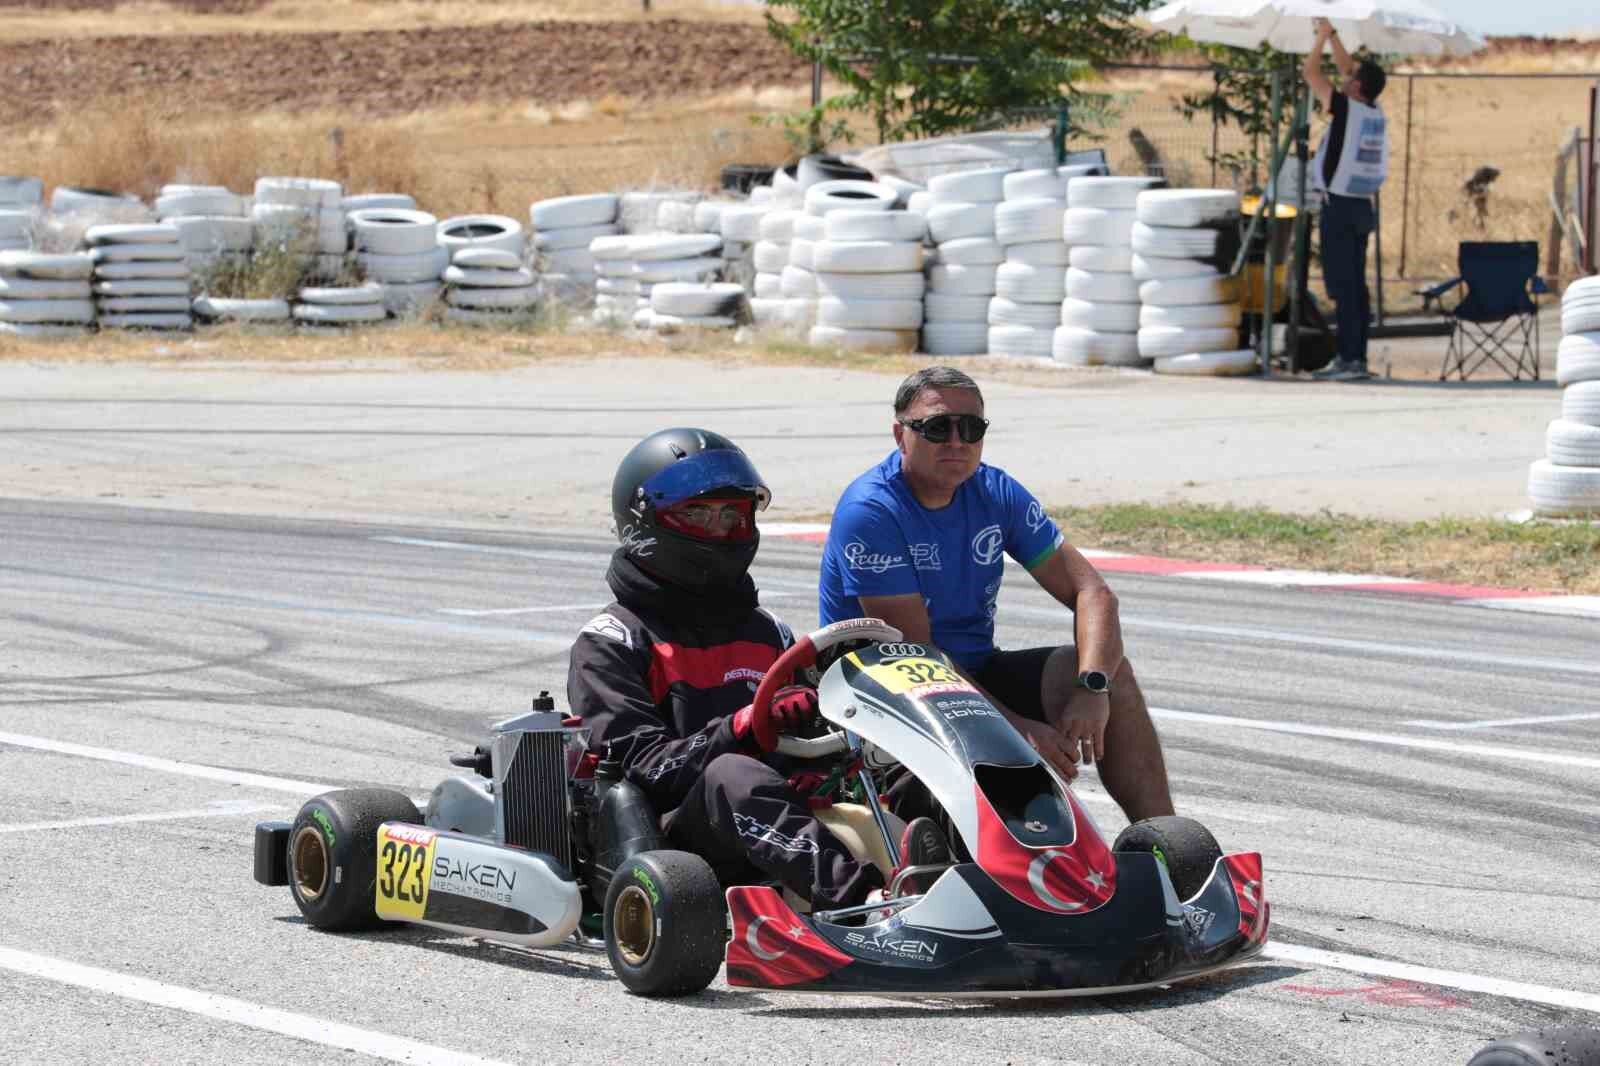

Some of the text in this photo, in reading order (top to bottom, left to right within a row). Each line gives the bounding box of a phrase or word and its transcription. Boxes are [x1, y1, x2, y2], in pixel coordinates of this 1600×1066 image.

[895, 663, 963, 684] 323
[380, 841, 426, 905] 323
[433, 856, 518, 891] SAKEN
[845, 930, 938, 956] SAKEN
